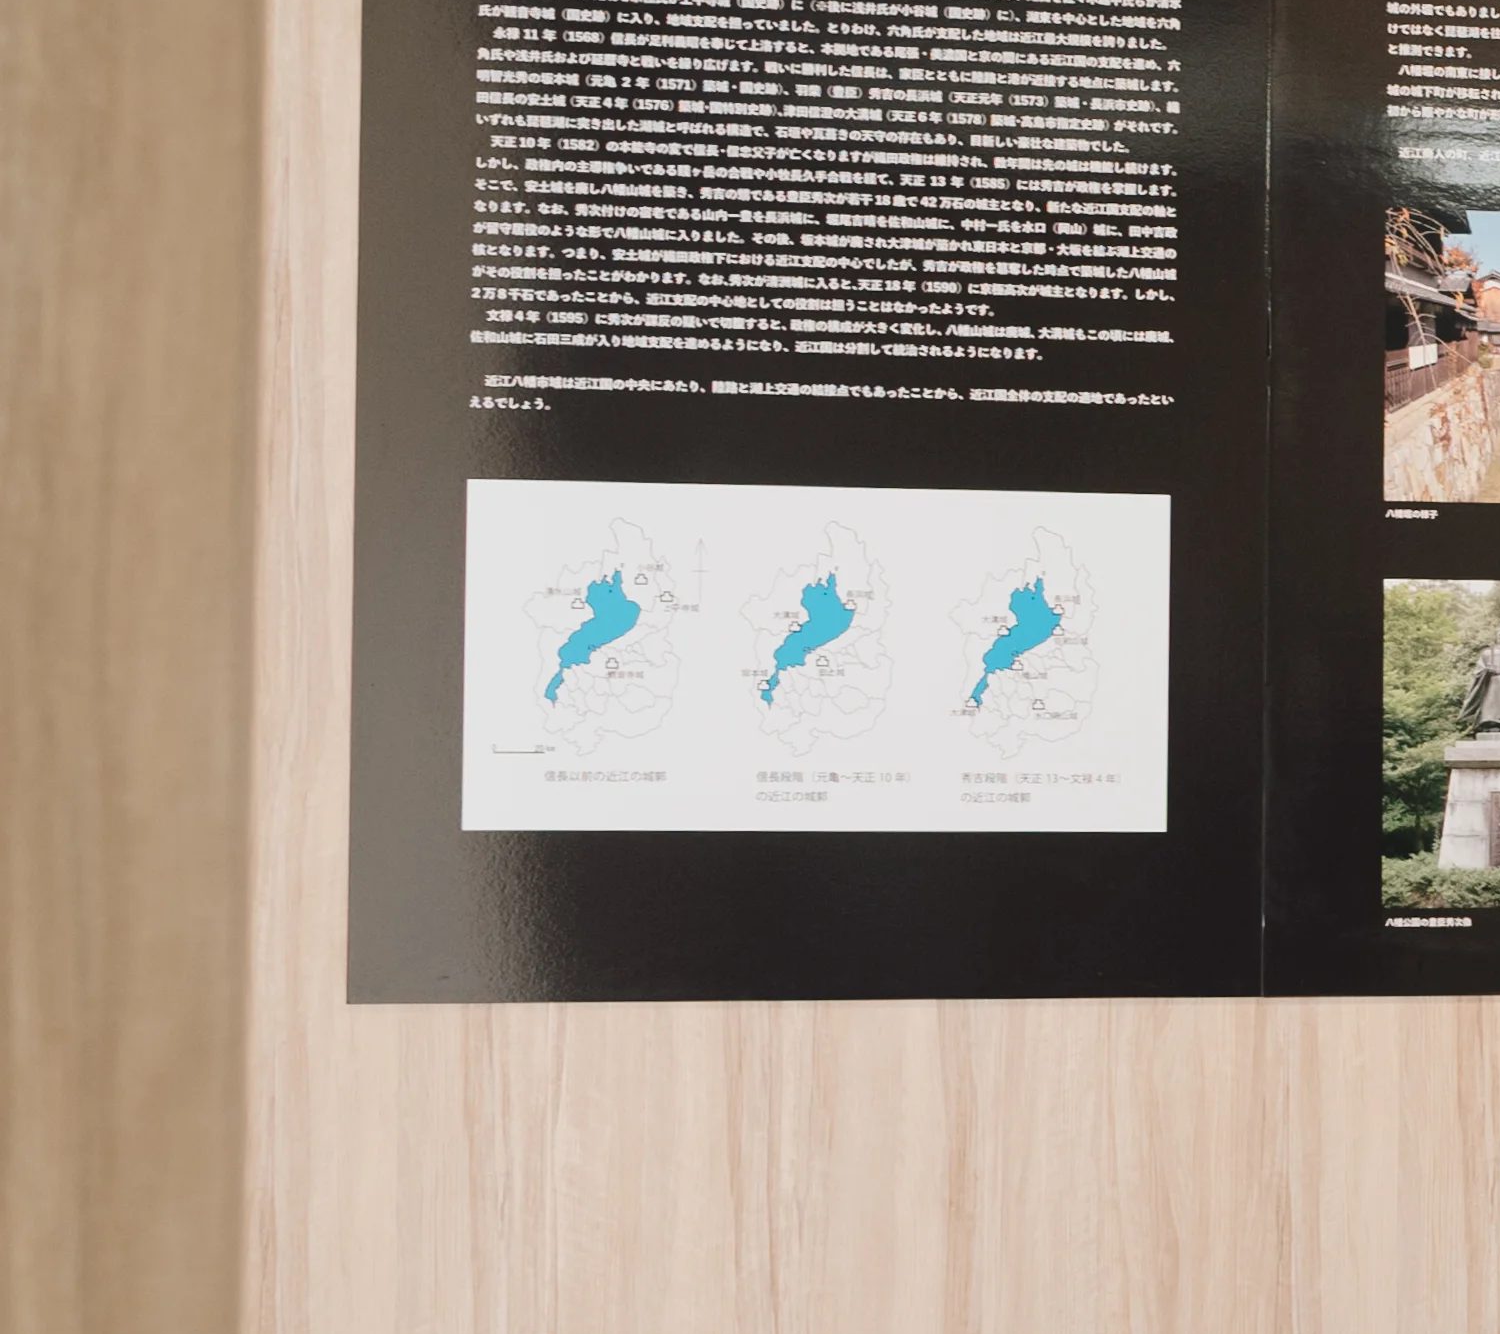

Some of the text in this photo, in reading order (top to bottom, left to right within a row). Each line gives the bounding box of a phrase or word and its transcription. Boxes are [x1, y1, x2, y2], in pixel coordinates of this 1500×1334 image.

[469, 396, 550, 410] えるでしょう。
